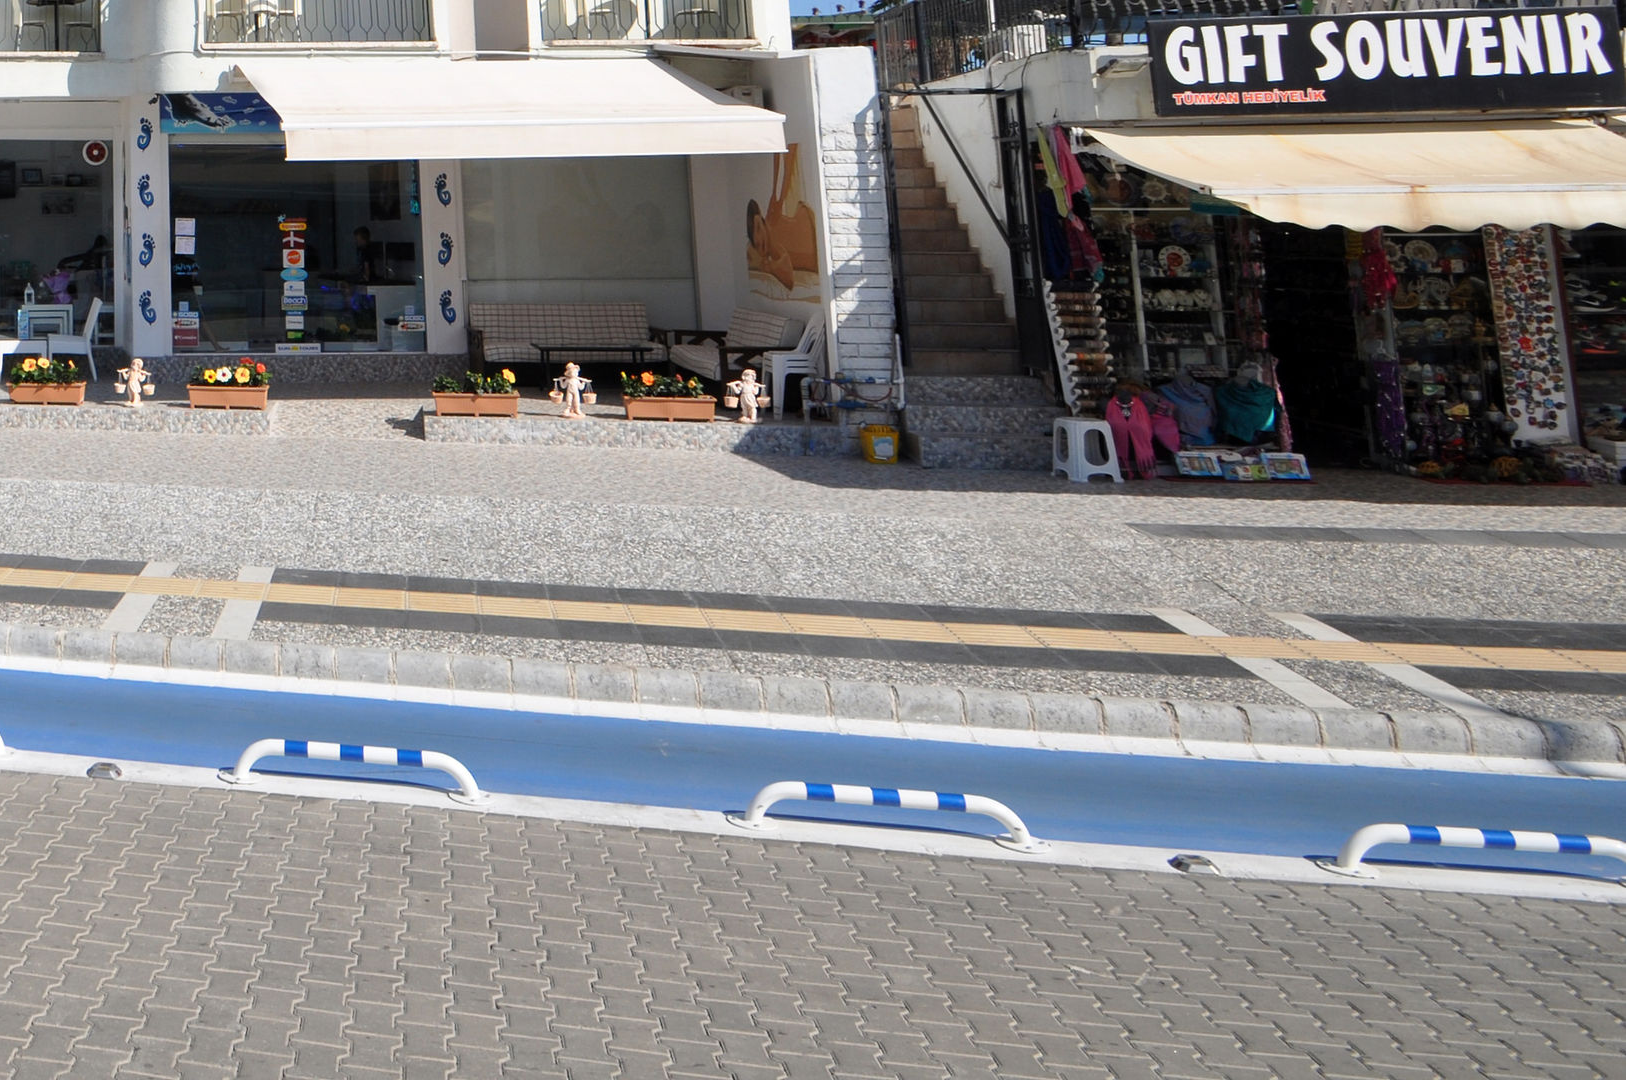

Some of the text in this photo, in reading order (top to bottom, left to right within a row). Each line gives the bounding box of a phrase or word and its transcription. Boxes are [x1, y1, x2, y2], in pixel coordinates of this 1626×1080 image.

[1165, 12, 1613, 85] GIFT SOUVENIR
[1173, 87, 1326, 106] TÜMKAN HEDİYELİK
